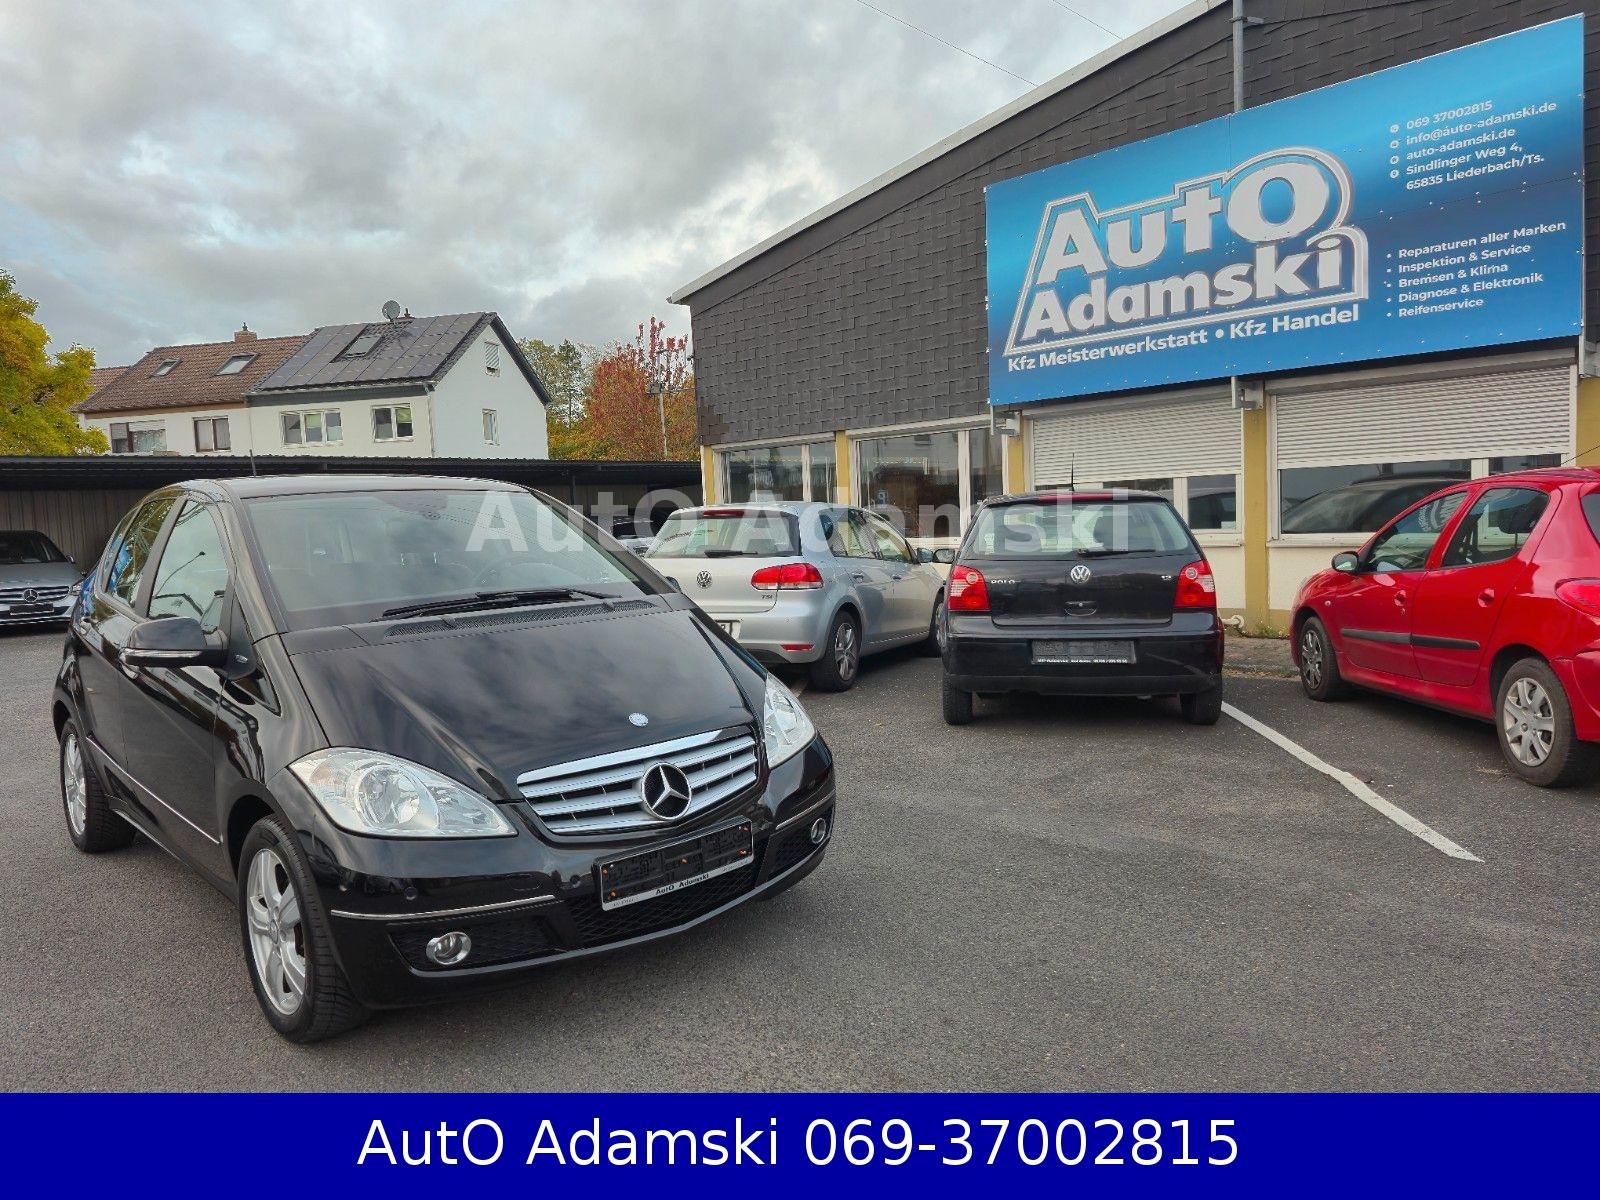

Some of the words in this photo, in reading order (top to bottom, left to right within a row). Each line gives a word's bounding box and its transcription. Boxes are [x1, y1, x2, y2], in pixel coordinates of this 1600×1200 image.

[1406, 114, 1430, 130] 069
[1433, 100, 1493, 125] 37002815
[1406, 102, 1557, 146] info@auto-adamski.de
[1406, 127, 1516, 160] auto-adamski.de
[1406, 153, 1471, 175] Sindlinger
[1474, 145, 1506, 160] Weg
[1509, 142, 1523, 152] 4,
[1406, 174, 1443, 191] 65835
[1446, 153, 1545, 182] Liederbach/Ts.
[1398, 237, 1477, 259] Reparaturen
[1480, 231, 1510, 245] aller
[1513, 221, 1566, 239] Marken
[1398, 254, 1465, 274] Inspektion
[1468, 250, 1478, 262] &
[1481, 244, 1531, 260] Service
[1021, 237, 1343, 341] Adamski
[1398, 271, 1454, 288] Bremsen
[1457, 269, 1467, 280] &
[1470, 264, 1509, 277] Klima
[1398, 286, 1458, 303] Diagnose
[1460, 283, 1470, 294] &
[1473, 272, 1543, 291] Elektronik
[1398, 298, 1484, 318] Reifenservice
[1007, 349, 1036, 372] Kfz
[1039, 329, 1208, 368] Meisterwerkstatt
[1229, 317, 1267, 340] Kfz
[1272, 304, 1360, 334] Handel
